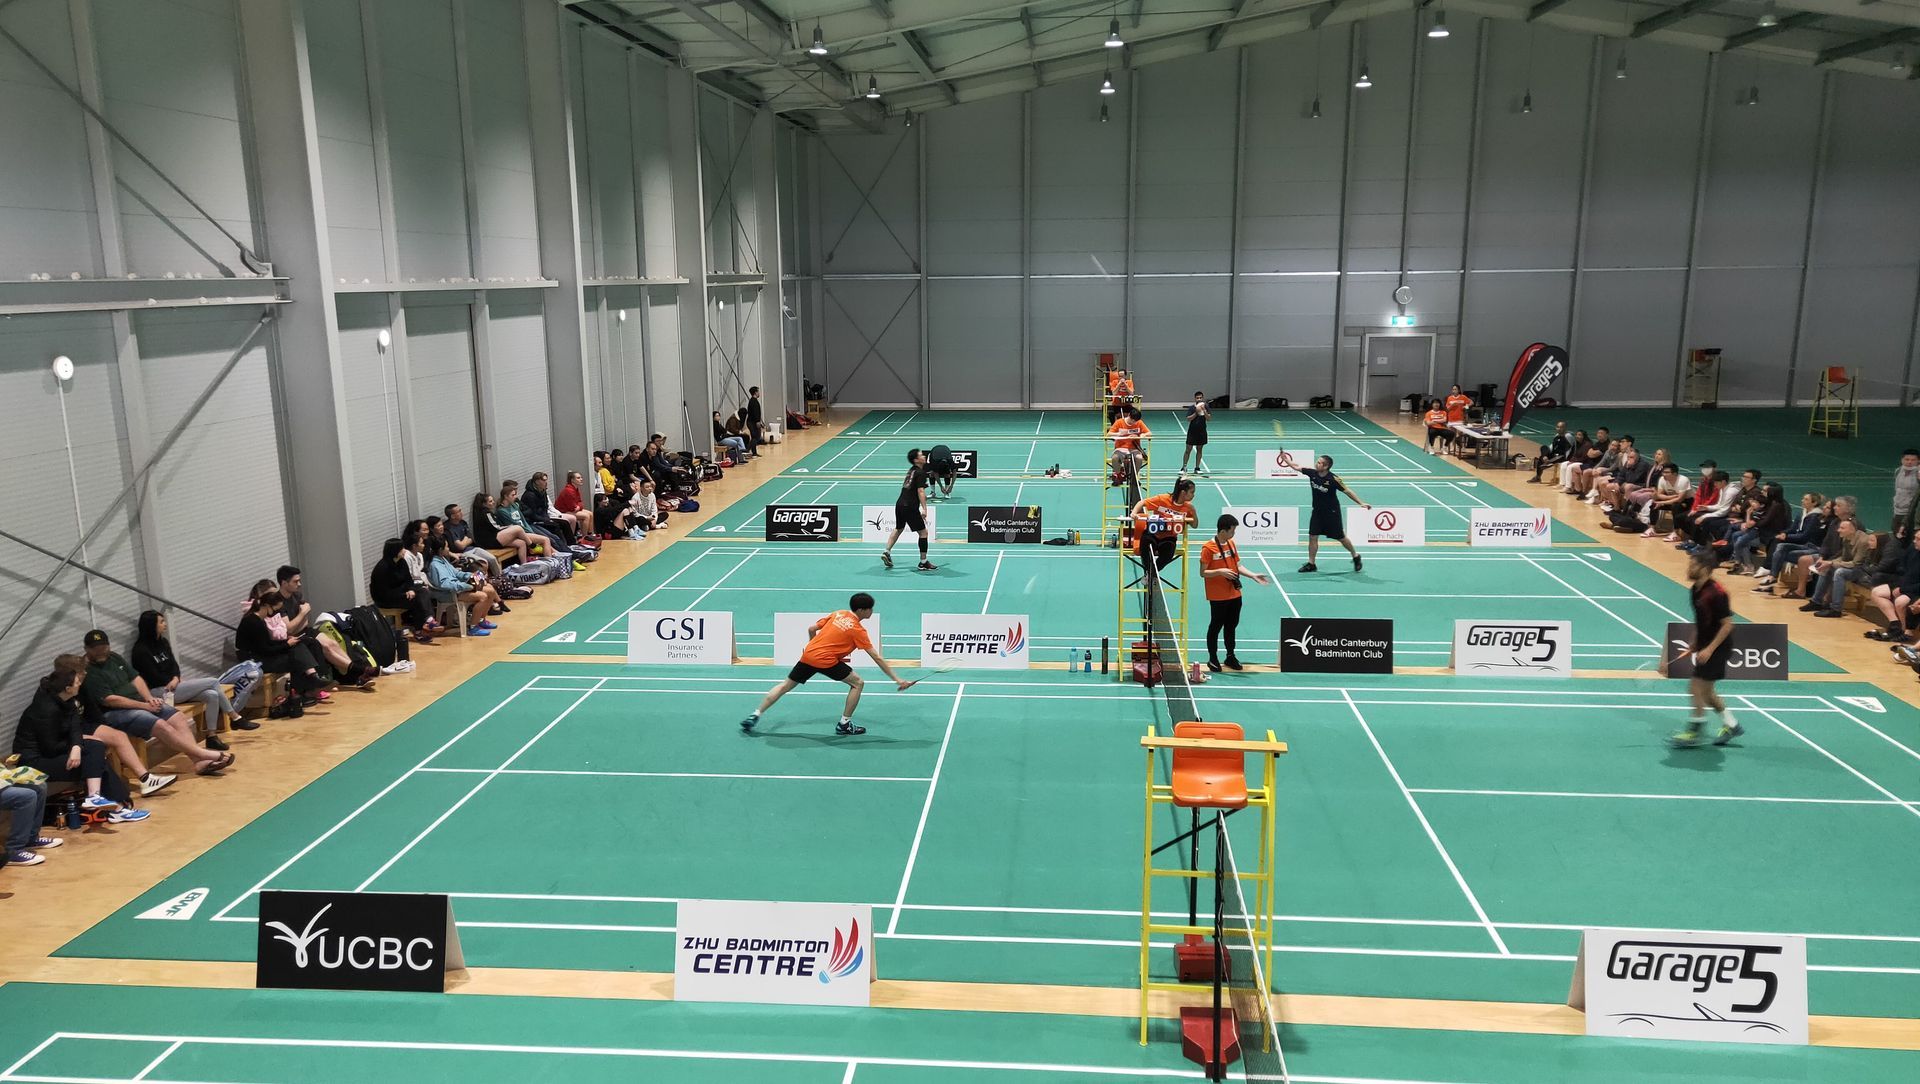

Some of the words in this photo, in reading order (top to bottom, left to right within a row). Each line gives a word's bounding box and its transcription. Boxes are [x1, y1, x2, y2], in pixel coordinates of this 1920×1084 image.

[1517, 355, 1563, 409] Garage5
[772, 508, 831, 532] Garage5
[1007, 519, 1038, 527] Canterbury
[1148, 523, 1158, 534] 0
[1174, 523, 1183, 534] 0
[1242, 511, 1278, 528] GSI
[1479, 528, 1528, 536] CENTRE
[519, 572, 544, 582] YONEX
[656, 617, 704, 640] GSI
[931, 642, 998, 654] CENTRE
[1310, 638, 1338, 647] United
[1340, 638, 1388, 649] Canterbury
[1466, 625, 1559, 662] Garage5
[1315, 649, 1361, 658] Badminton
[1363, 649, 1383, 659] Club
[1726, 648, 1781, 668] CBC
[234, 672, 253, 695] NEX
[165, 891, 203, 917] BWF
[318, 936, 434, 971] UCBC
[683, 937, 720, 950] ZHU
[725, 938, 830, 954] BADMINTON
[693, 953, 816, 977] CENTRE
[1606, 940, 1783, 1014] Garage5
